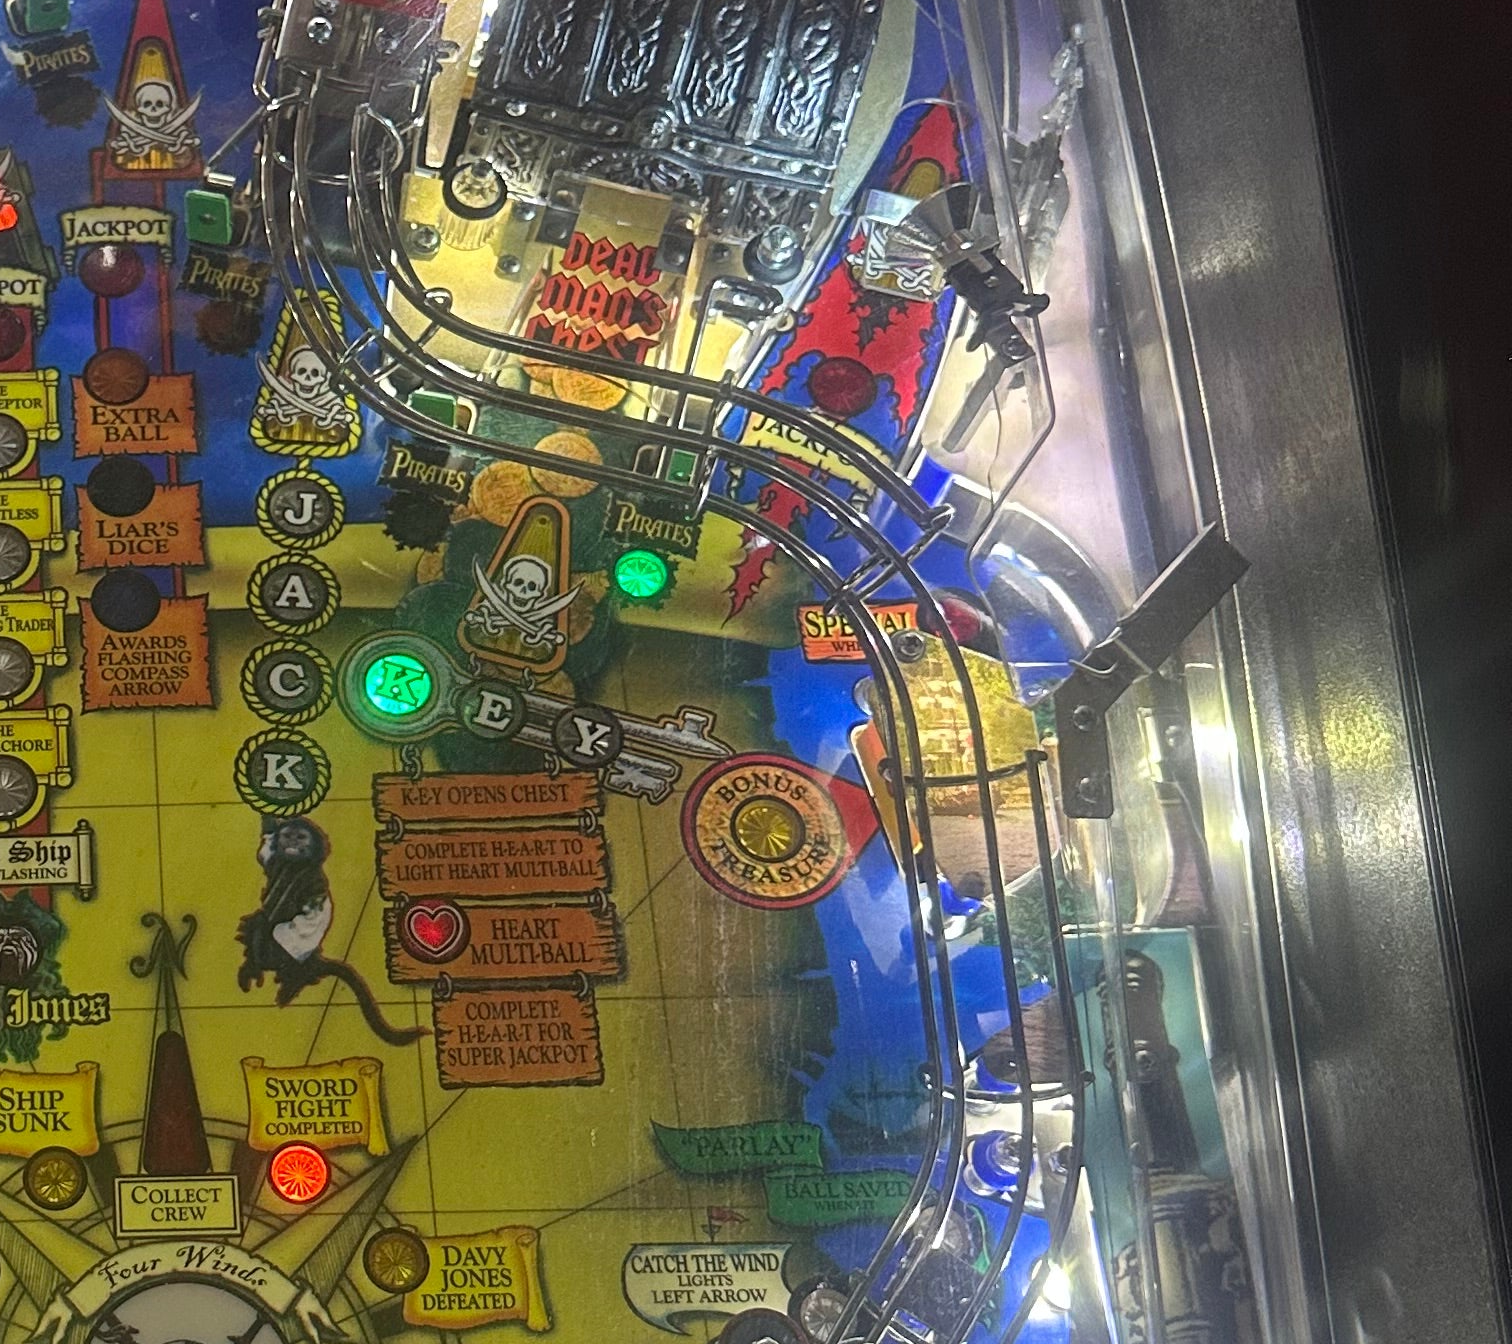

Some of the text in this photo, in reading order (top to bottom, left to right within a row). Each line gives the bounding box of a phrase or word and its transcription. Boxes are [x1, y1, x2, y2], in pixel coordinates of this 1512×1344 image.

[21, 46, 92, 77] PIRATES
[65, 219, 168, 240] JACKPOT
[190, 259, 263, 296] PIRATES
[90, 406, 180, 426] EXTRA
[104, 425, 168, 442] BALL
[390, 450, 467, 493] PIRATES
[95, 520, 179, 540] LIAR'S
[615, 500, 693, 545] PIRATES
[107, 540, 168, 555] DICE
[4, 618, 54, 633] TRADER
[100, 633, 186, 651] AWARDS
[97, 651, 191, 666] FLASHING
[100, 665, 189, 682] COMPASS
[108, 681, 183, 697] ARROW
[400, 784, 569, 805] K-E-Y OPENS CHEST
[715, 772, 806, 804] BONUS
[8, 840, 72, 865] Ship
[405, 839, 583, 859] COMPLETE H-E-A-R-T TO
[711, 835, 829, 884] TREASURE
[397, 860, 598, 881] LIGHT HEART MULTI-BALL
[490, 918, 560, 940] HEART
[470, 943, 594, 965] MULTI-BALL
[7, 987, 110, 1028] Jones
[465, 1001, 561, 1020] COMPLETE
[458, 1023, 573, 1042] H-E-A-R-T FOR
[447, 1045, 589, 1068] SUPER JACKPOT
[265, 1078, 357, 1098] SWORD
[275, 1099, 352, 1118] FIGHT
[265, 1121, 363, 1136] COMPLETED
[131, 1185, 222, 1205] COLLECT
[783, 1180, 911, 1200] BALL SAVED
[151, 1206, 207, 1222] CREW
[442, 1245, 507, 1267] DAVY
[631, 1252, 780, 1274] CATCH THE WIND
[97, 1245, 267, 1288] Four Winds
[440, 1268, 513, 1292] JONES
[677, 1274, 734, 1288] LIGHTS
[421, 1292, 516, 1312] DEFEATED
[652, 1288, 767, 1304] LEFT ARROW
